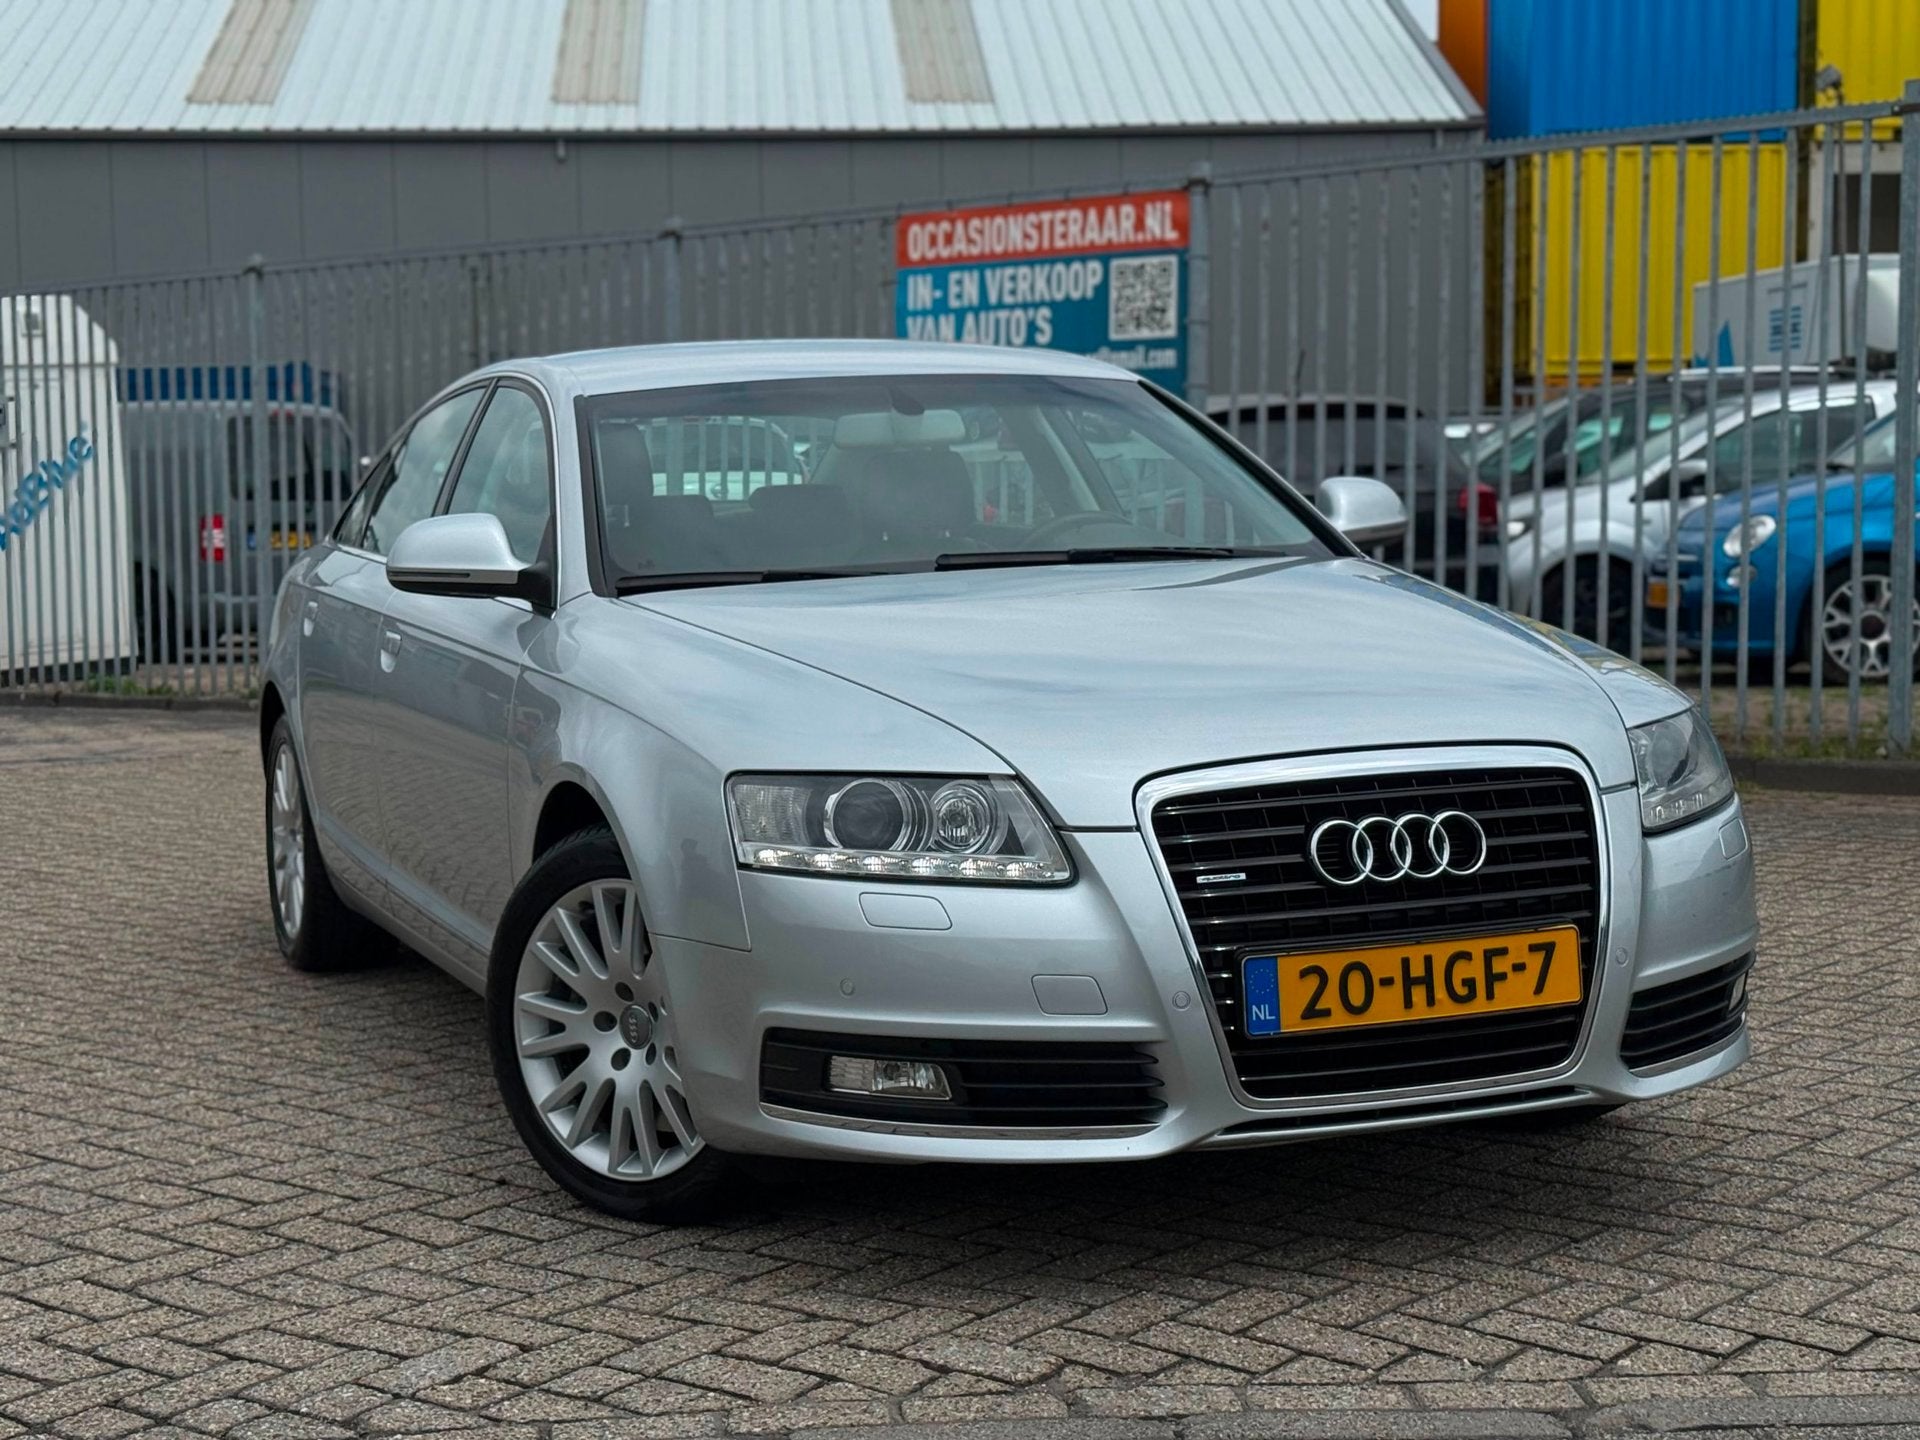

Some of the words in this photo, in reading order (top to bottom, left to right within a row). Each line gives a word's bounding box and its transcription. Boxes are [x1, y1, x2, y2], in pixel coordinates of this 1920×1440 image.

[907, 201, 1179, 261] OCCASIONSTERAAR.NL
[907, 273, 943, 311] IN-
[948, 270, 979, 308] EN
[984, 260, 1103, 306] VERKOOP
[906, 313, 956, 342] VAN
[961, 306, 1053, 346] AUTO'S
[1299, 941, 1557, 1020] 20-HGF-7
[1252, 1004, 1276, 1021] NL
